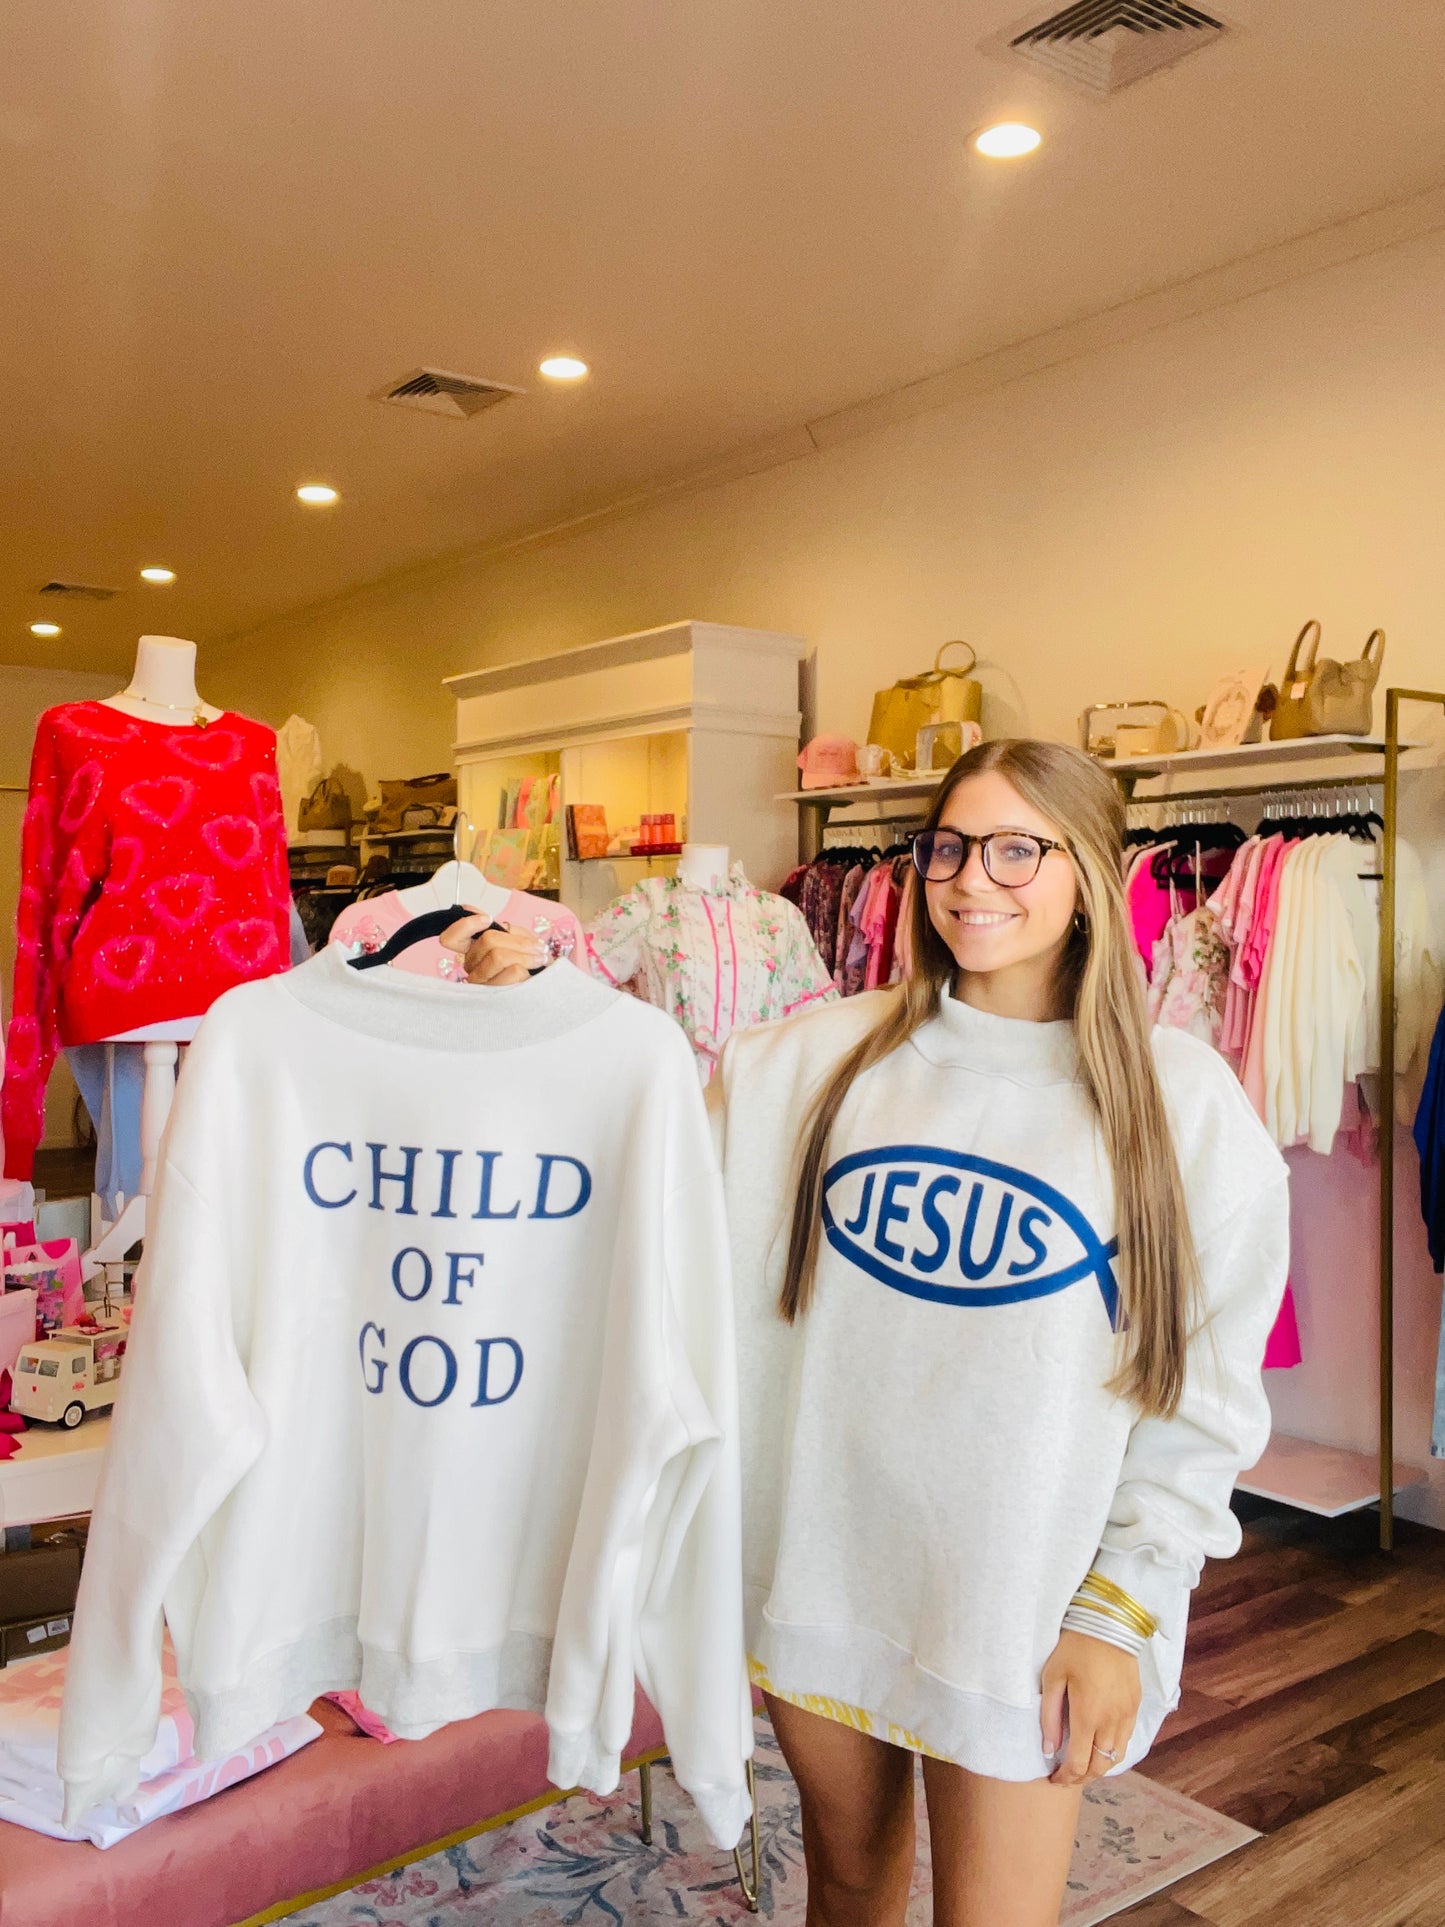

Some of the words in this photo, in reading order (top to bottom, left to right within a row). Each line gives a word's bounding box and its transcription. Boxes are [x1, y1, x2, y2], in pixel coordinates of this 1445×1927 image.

[304, 1142, 592, 1219] CHILD
[844, 1170, 1052, 1281] JESUS
[391, 1247, 485, 1305] OF
[359, 1321, 525, 1408] GOD
